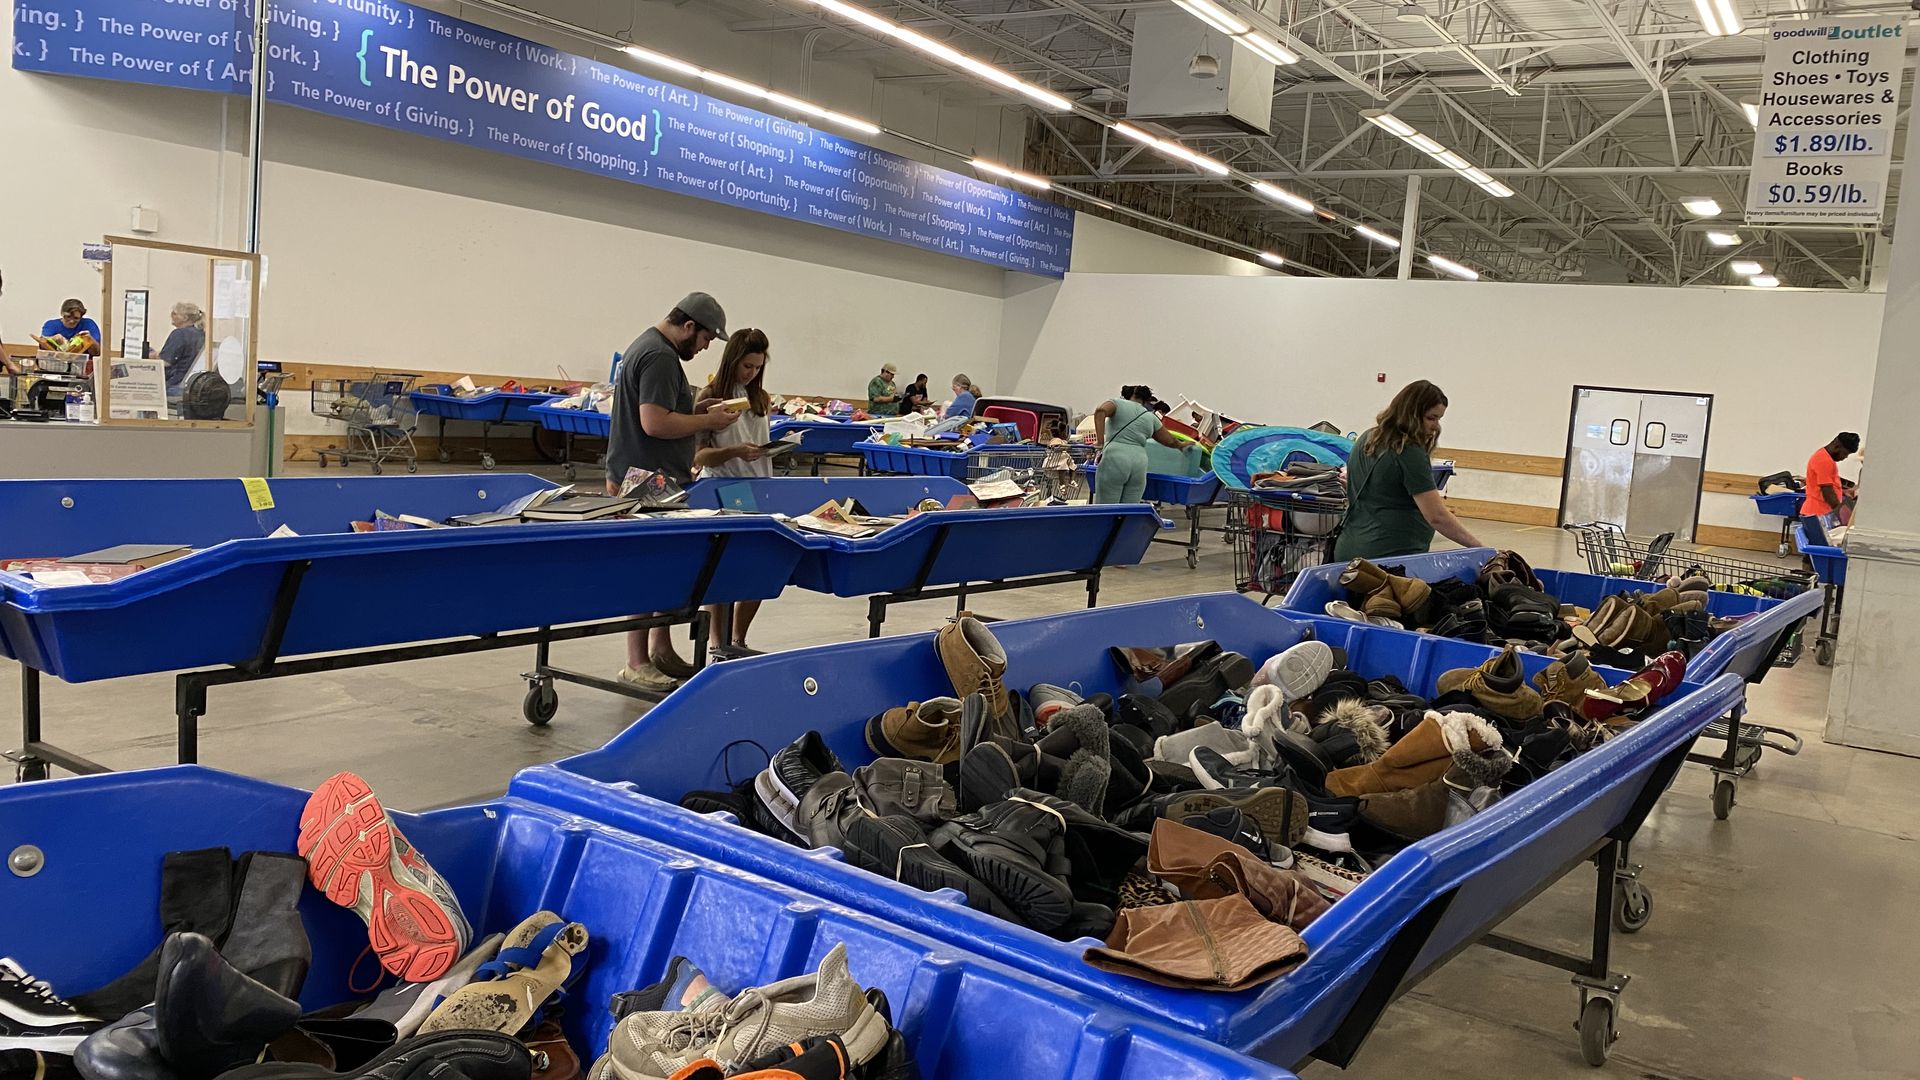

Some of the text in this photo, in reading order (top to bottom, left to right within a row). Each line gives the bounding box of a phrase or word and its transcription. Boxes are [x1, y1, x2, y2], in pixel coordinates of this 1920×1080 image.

[98, 17, 134, 36] The
[141, 22, 202, 43] Power
[208, 32, 228, 47] of
[266, 4, 327, 38] iving.
[1773, 24, 1903, 40] goodwill outlet
[428, 19, 452, 38] The
[455, 27, 496, 50] Power
[499, 42, 512, 55] of
[525, 45, 567, 71] Work.
[1792, 49, 1870, 66] Clothing
[69, 47, 105, 65] The
[112, 52, 174, 73] Power
[179, 61, 200, 76] of
[380, 45, 438, 89] The
[448, 64, 539, 113] Power
[546, 94, 575, 123] of
[582, 101, 647, 142] Good
[591, 66, 610, 84] The
[613, 74, 645, 95] Power
[648, 86, 659, 98] of
[669, 89, 690, 107] Art.
[1772, 69, 1890, 87] Shoes Toys
[292, 80, 320, 99] The
[325, 89, 371, 111] Power
[375, 102, 391, 116] of
[406, 106, 463, 135] Giving.
[1762, 89, 1895, 107] Housewares &
[707, 102, 724, 117] The
[725, 109, 752, 125] Power
[755, 118, 764, 129] of
[772, 121, 807, 144] Giving.
[1768, 111, 1882, 127] Accessories
[487, 127, 510, 143] The
[513, 133, 549, 152] Power
[552, 143, 565, 155] of
[577, 145, 640, 175] Shopping.
[668, 117, 685, 131] The
[688, 123, 716, 141] Power
[719, 132, 728, 143] of
[737, 134, 787, 163] Shopping.
[1774, 134, 1873, 155] $1.89/lb.
[680, 147, 697, 161] The
[699, 152, 727, 169] Power
[729, 161, 739, 172] of
[747, 163, 766, 180] Art.
[820, 137, 833, 152] The
[834, 144, 858, 160] Power
[858, 151, 867, 161] of
[873, 154, 914, 179] Shopping.
[1786, 161, 1844, 176] Books
[657, 167, 675, 181] The
[677, 172, 706, 189] Power
[708, 180, 719, 191] of
[727, 182, 791, 211] Opportunity.
[803, 155, 817, 169] The
[819, 162, 842, 178] Power
[842, 169, 851, 179] of
[858, 171, 910, 196] Opportunity.
[924, 171, 934, 179] The
[936, 175, 955, 189] Power
[955, 180, 961, 189] of
[785, 175, 799, 190] The
[800, 180, 823, 195] Power
[826, 188, 834, 198] of
[841, 190, 872, 209] Giving.
[922, 192, 986, 217] The Power of Work.
[1768, 184, 1868, 205] $0.59/lb.
[808, 204, 887, 234] The Power of Work.
[884, 203, 967, 235] The Power of Shopping.
[899, 228, 959, 251] The Power of Art.
